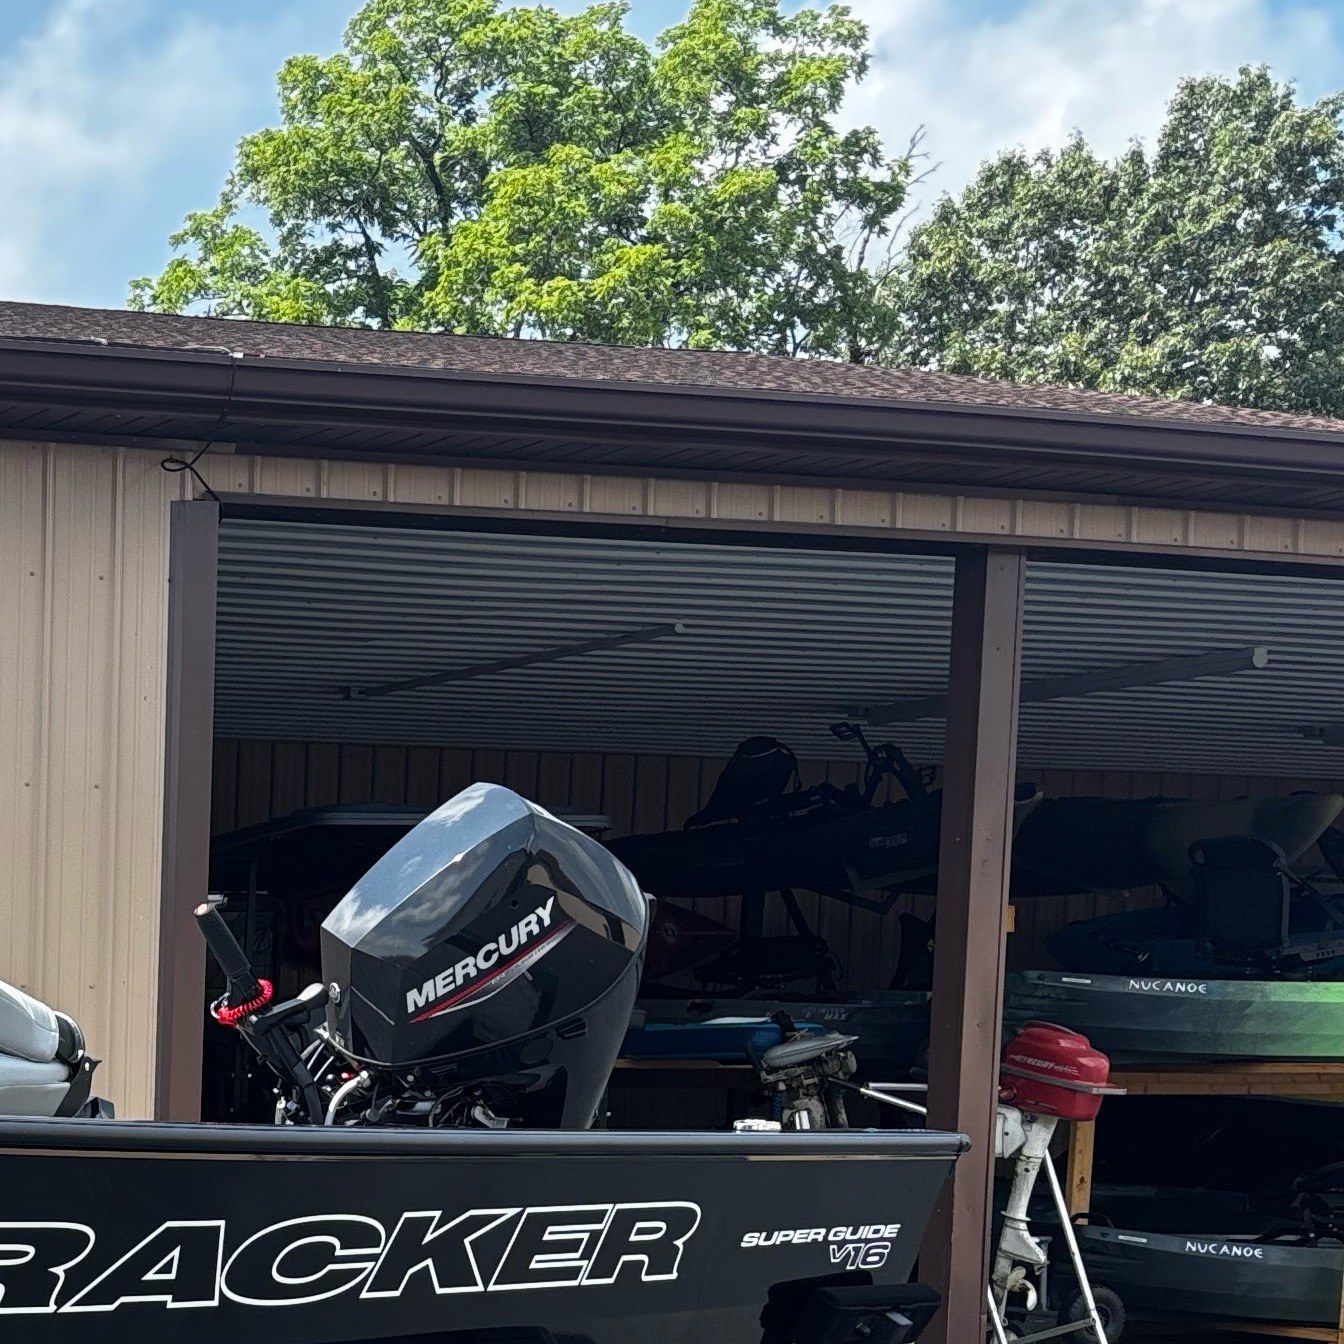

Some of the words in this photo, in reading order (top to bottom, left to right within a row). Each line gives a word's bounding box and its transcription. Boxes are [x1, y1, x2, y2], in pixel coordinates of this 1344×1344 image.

[406, 896, 555, 1013] MERCURY
[1128, 979, 1207, 994] NUCANOE
[740, 1228, 826, 1248] SUPER
[827, 1223, 901, 1241] GUIDE
[829, 1241, 892, 1271] V16
[1184, 1241, 1264, 1259] NUCANOE
